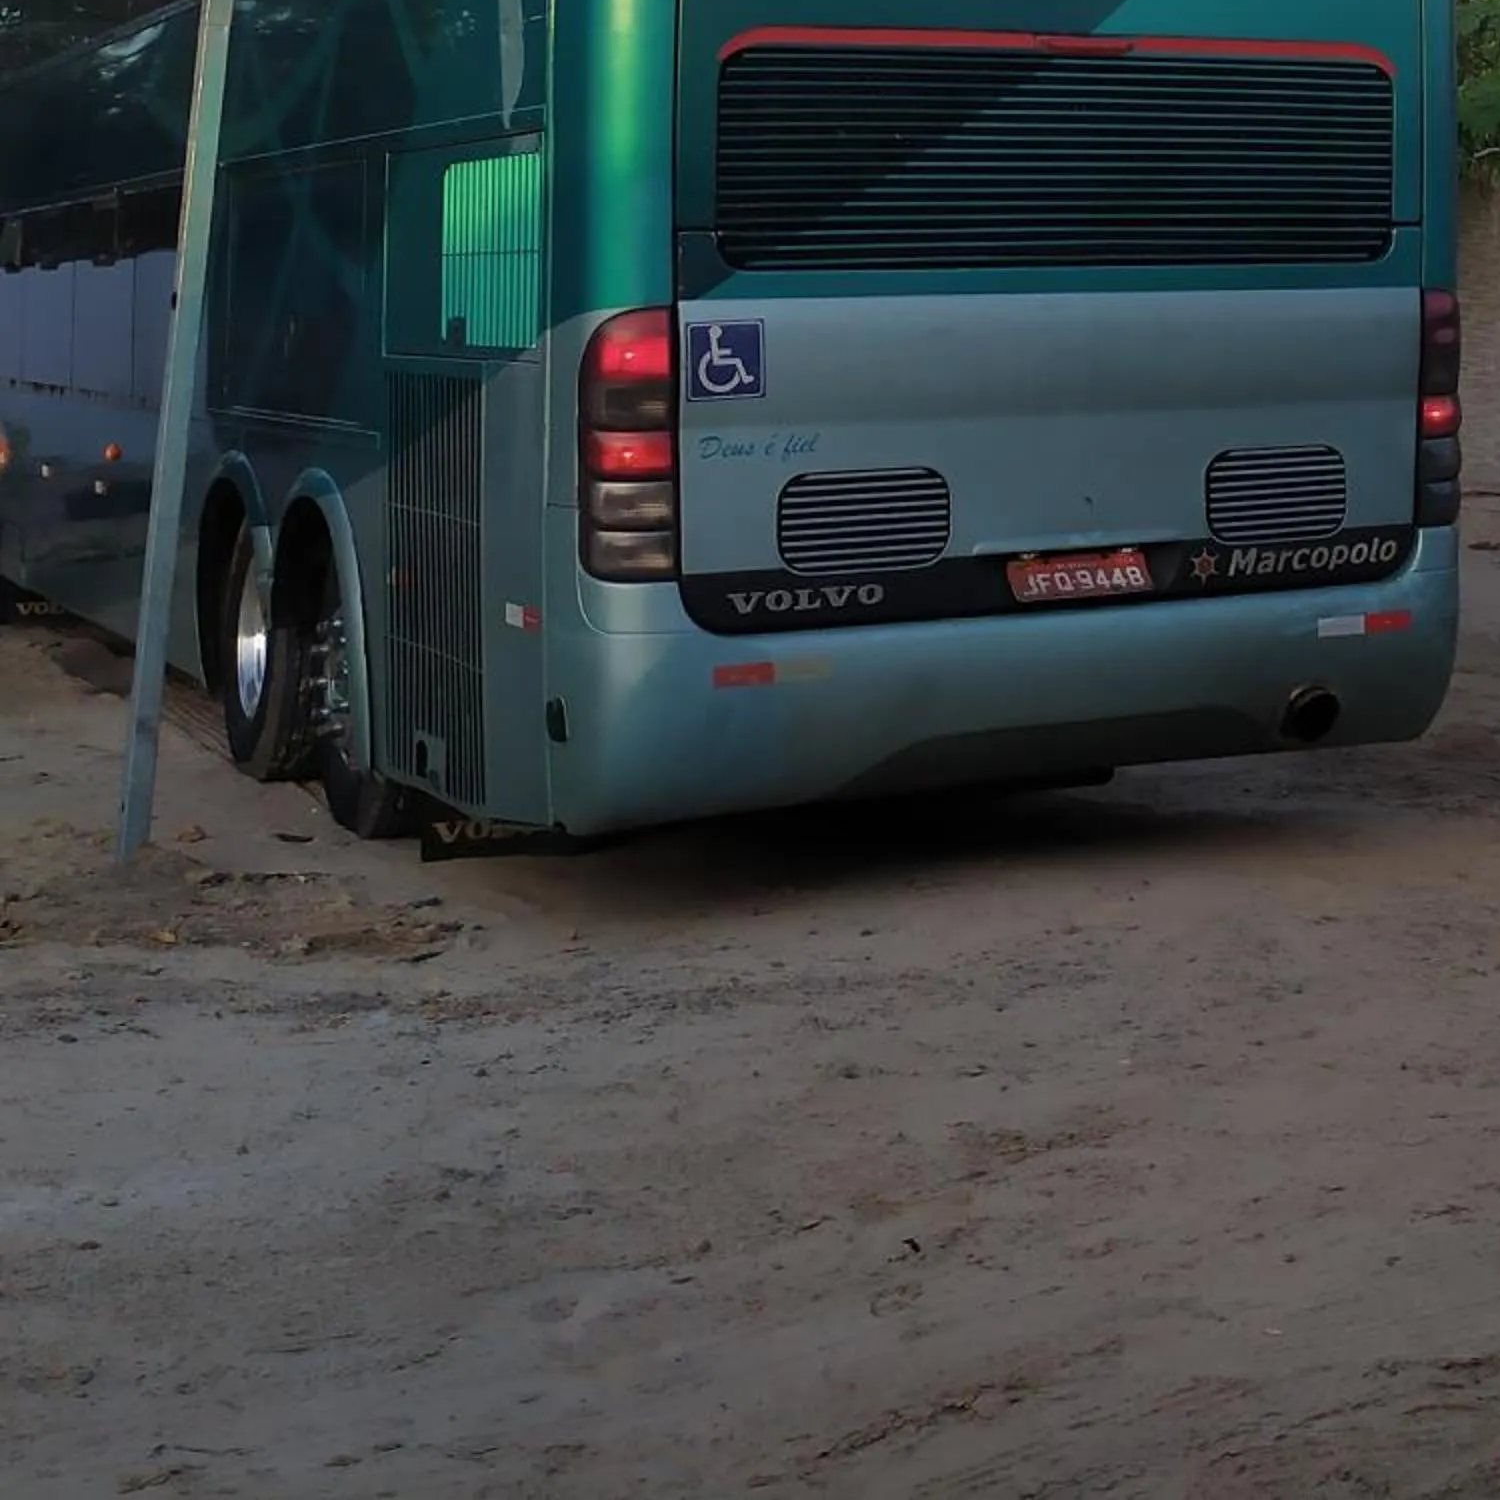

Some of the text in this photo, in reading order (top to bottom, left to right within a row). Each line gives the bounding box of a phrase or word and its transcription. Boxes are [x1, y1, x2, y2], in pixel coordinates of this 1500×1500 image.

[699, 435, 756, 459] Deus
[780, 432, 821, 462] fiel
[1227, 537, 1398, 578] Marcopolo
[726, 583, 885, 615] VOLVO
